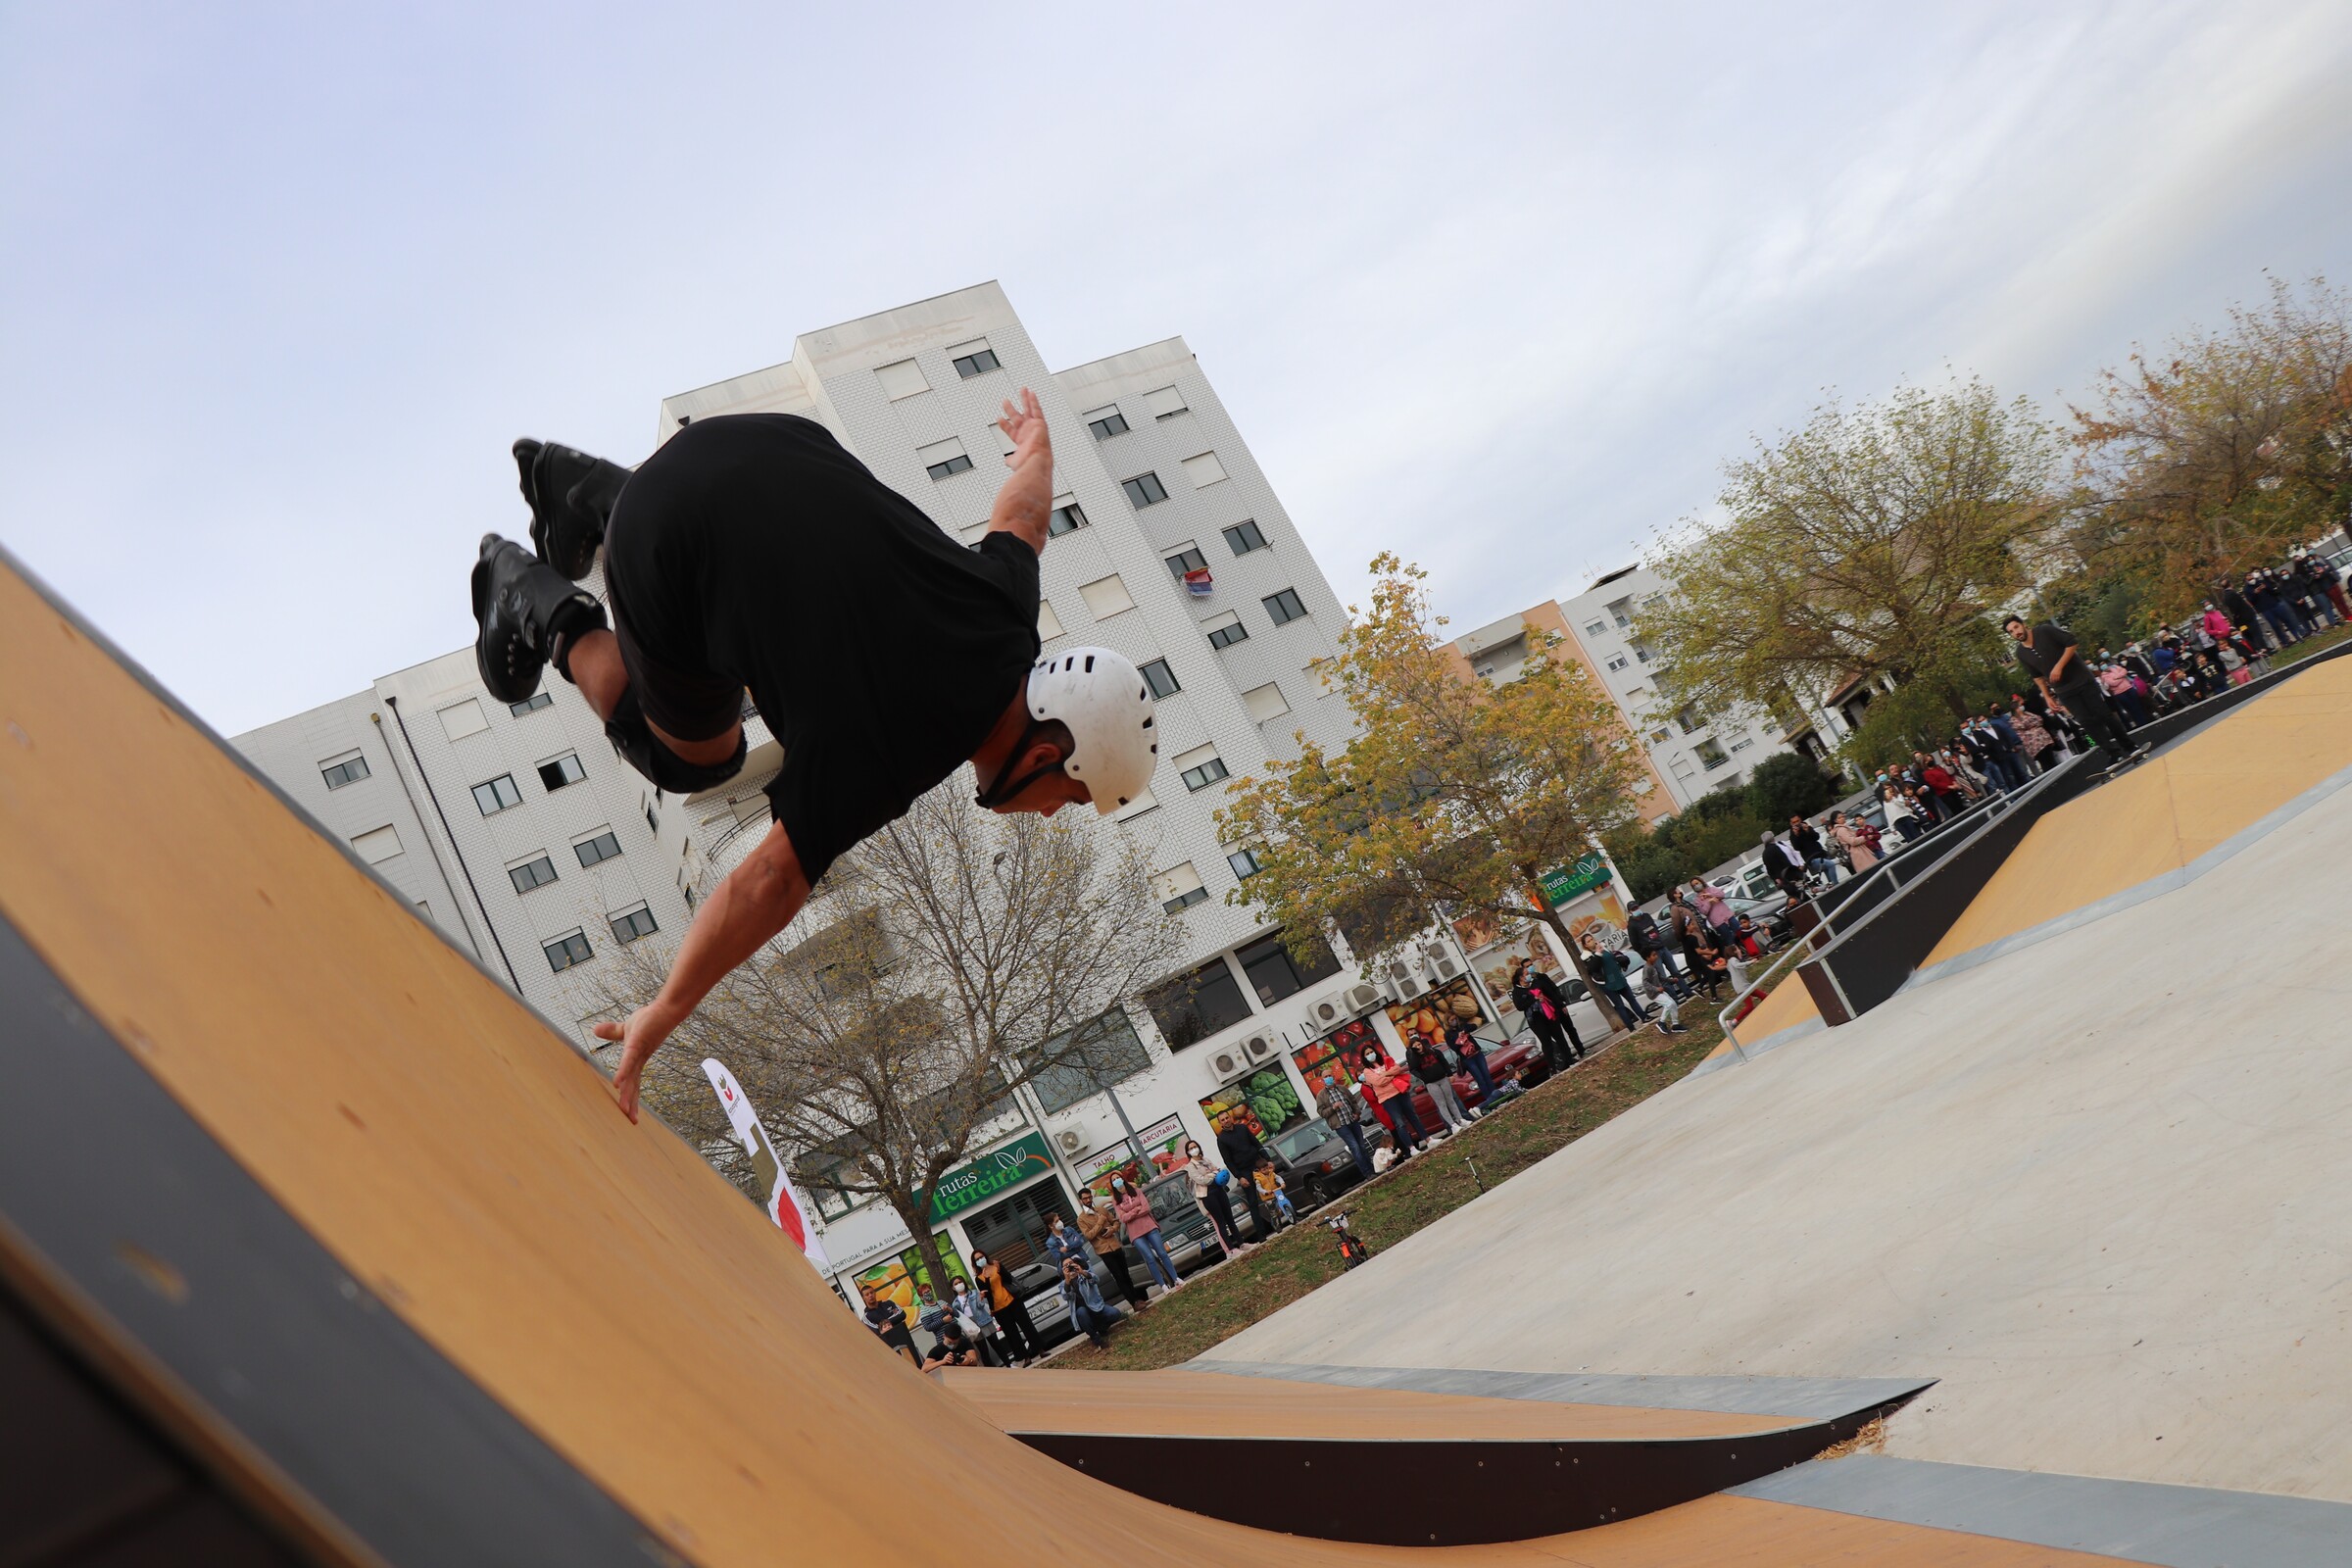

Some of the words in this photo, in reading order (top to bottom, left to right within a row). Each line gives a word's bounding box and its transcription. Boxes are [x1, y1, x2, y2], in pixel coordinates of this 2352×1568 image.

[1600, 930, 1629, 948] TARIA
[1139, 1123, 1177, 1146] HARCUTARIA
[1093, 1153, 1115, 1169] TALHO
[832, 1252, 862, 1270] PORTUGAL
[862, 1245, 877, 1254] PARA
[884, 1235, 896, 1245] SUA
